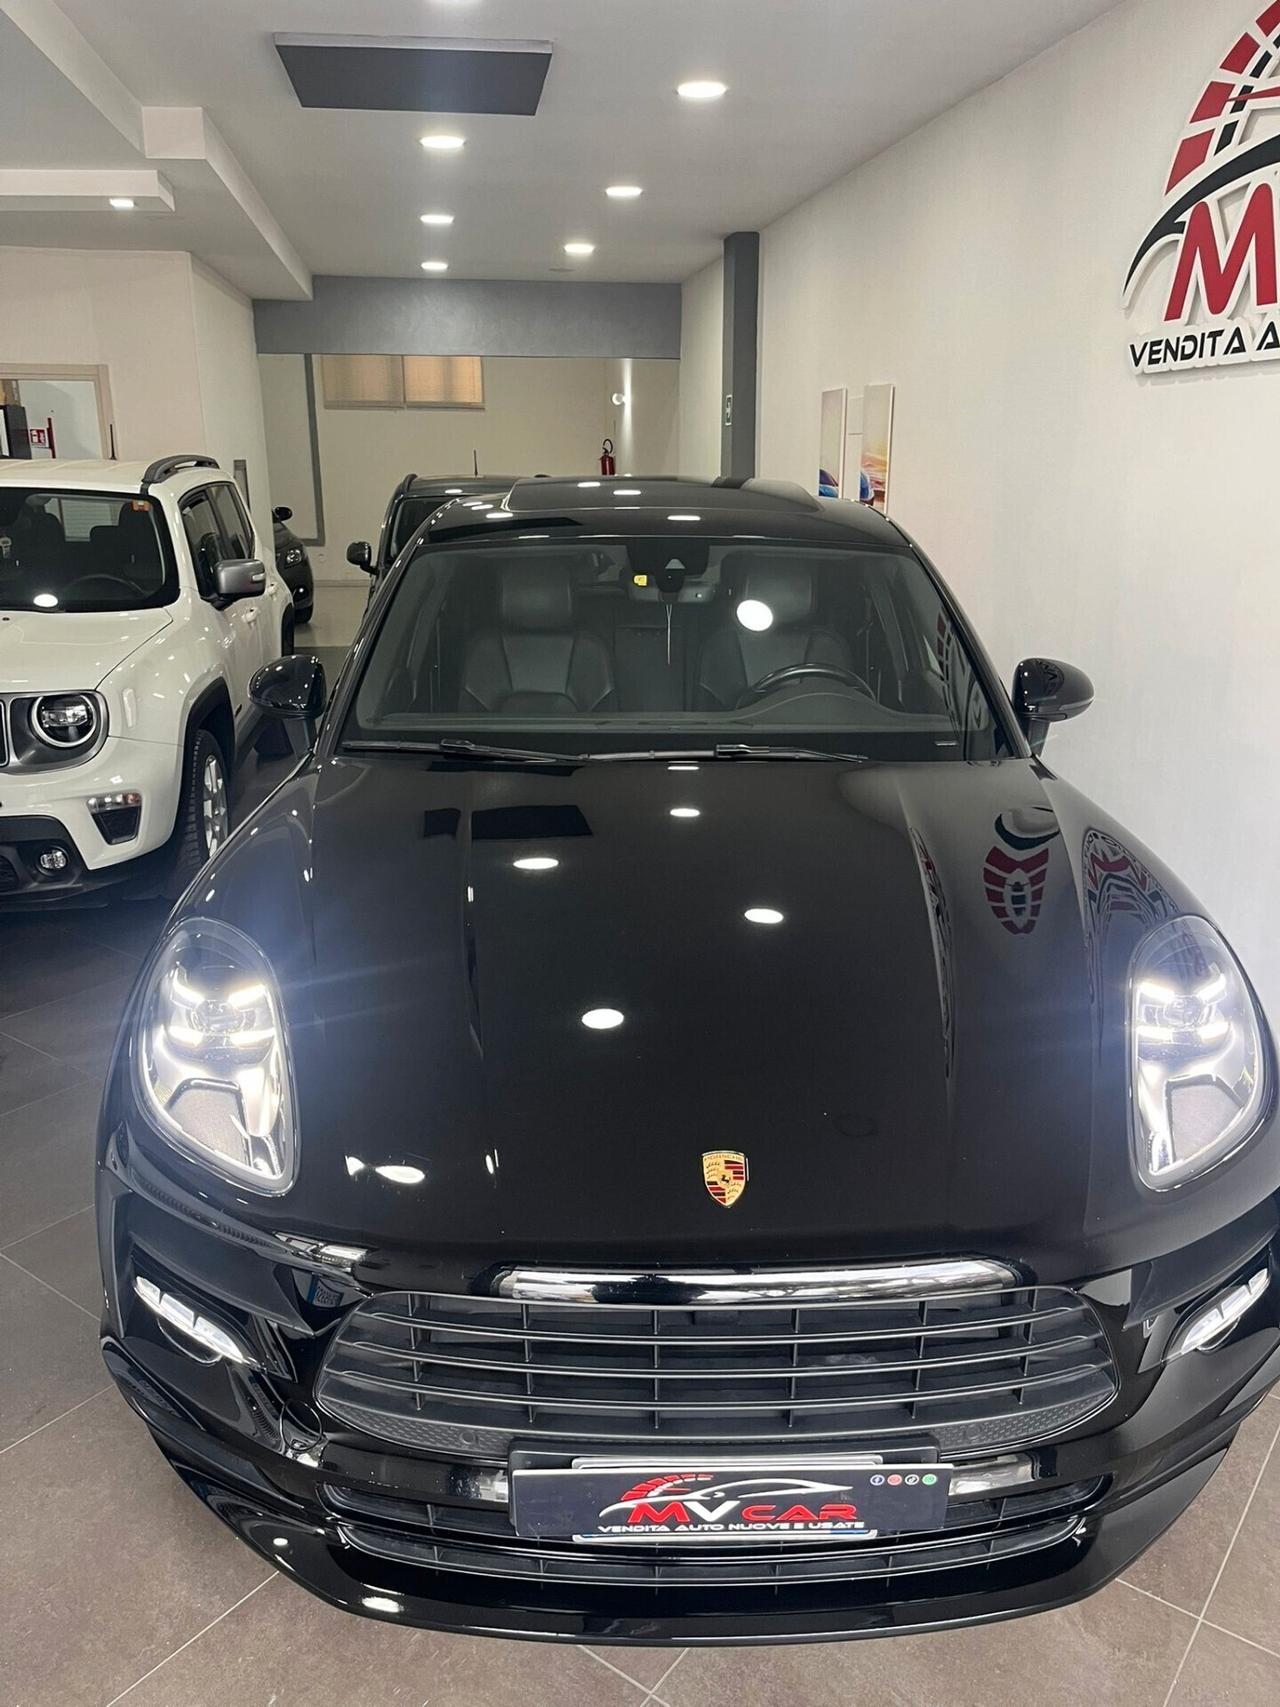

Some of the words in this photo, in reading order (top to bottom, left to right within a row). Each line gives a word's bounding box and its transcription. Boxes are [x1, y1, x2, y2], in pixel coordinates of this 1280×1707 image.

[1129, 326, 1247, 367] VENDITA
[597, 1525, 671, 1533] VENDITA
[674, 1523, 725, 1532] AUTO
[728, 1522, 790, 1531] NUOVE
[793, 1522, 805, 1530] E
[808, 1521, 865, 1530] USATE
